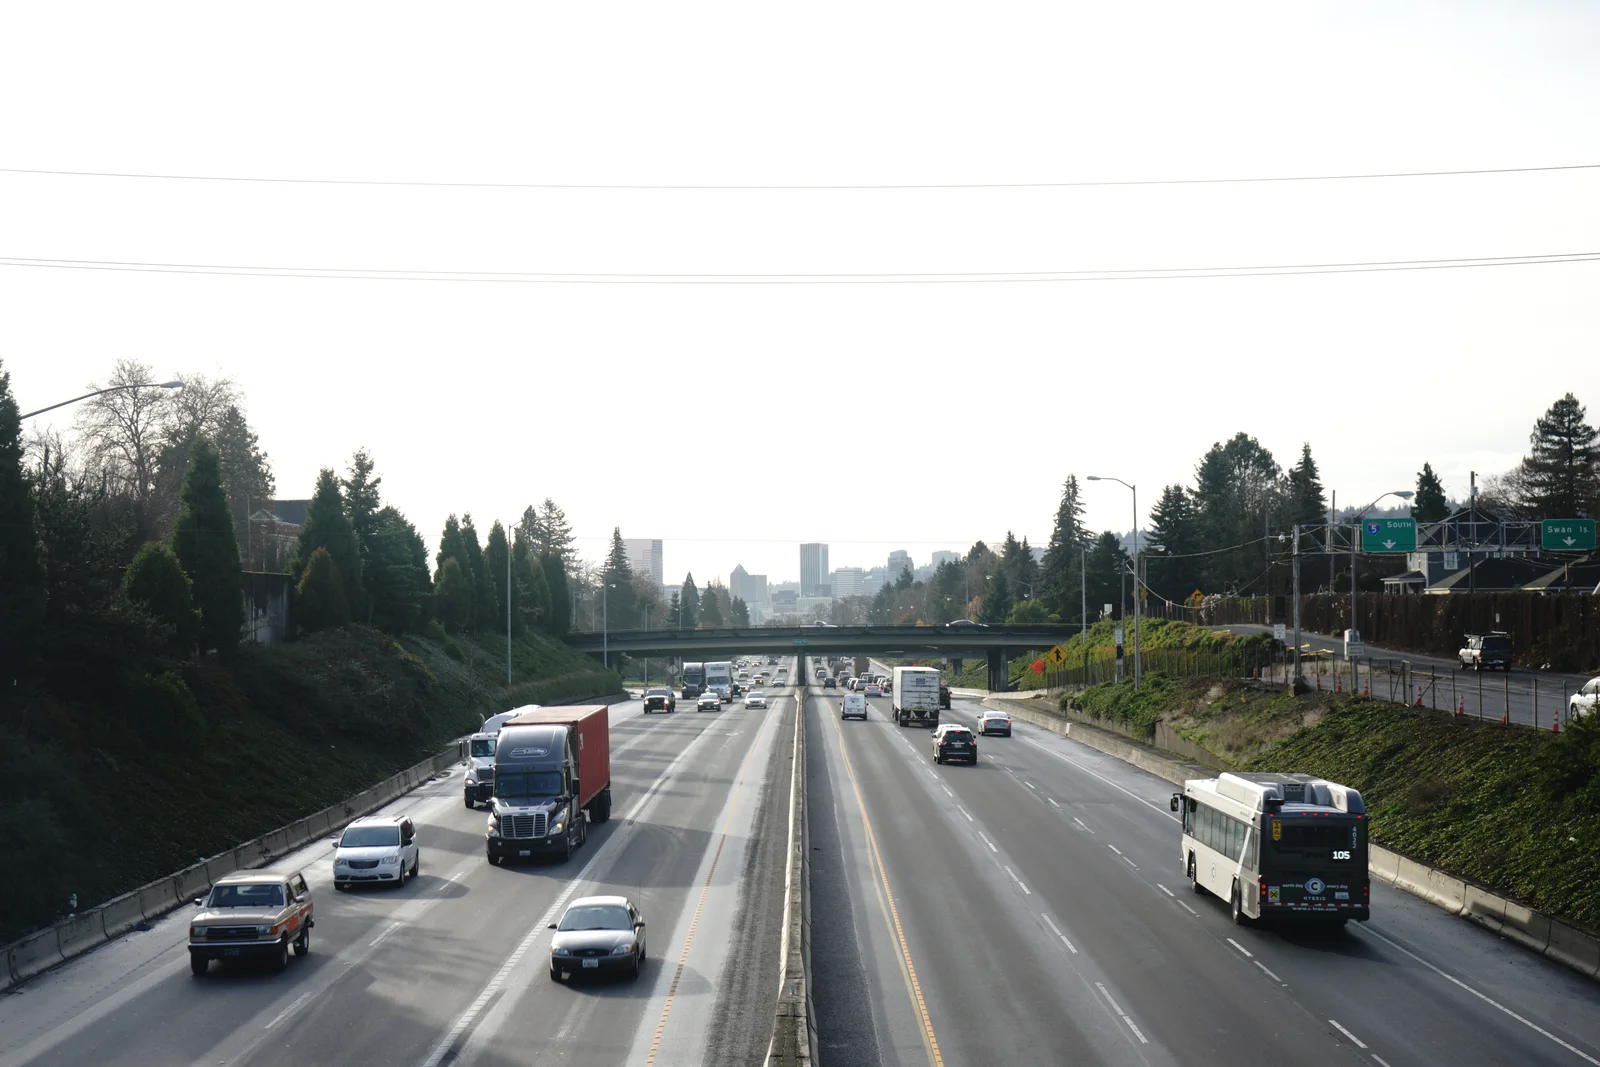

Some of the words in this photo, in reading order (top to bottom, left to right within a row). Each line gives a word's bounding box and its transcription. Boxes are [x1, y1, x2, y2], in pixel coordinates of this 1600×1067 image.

[1371, 524, 1377, 534] 5
[1547, 525, 1572, 533] Swan
[1333, 851, 1350, 859] 105
